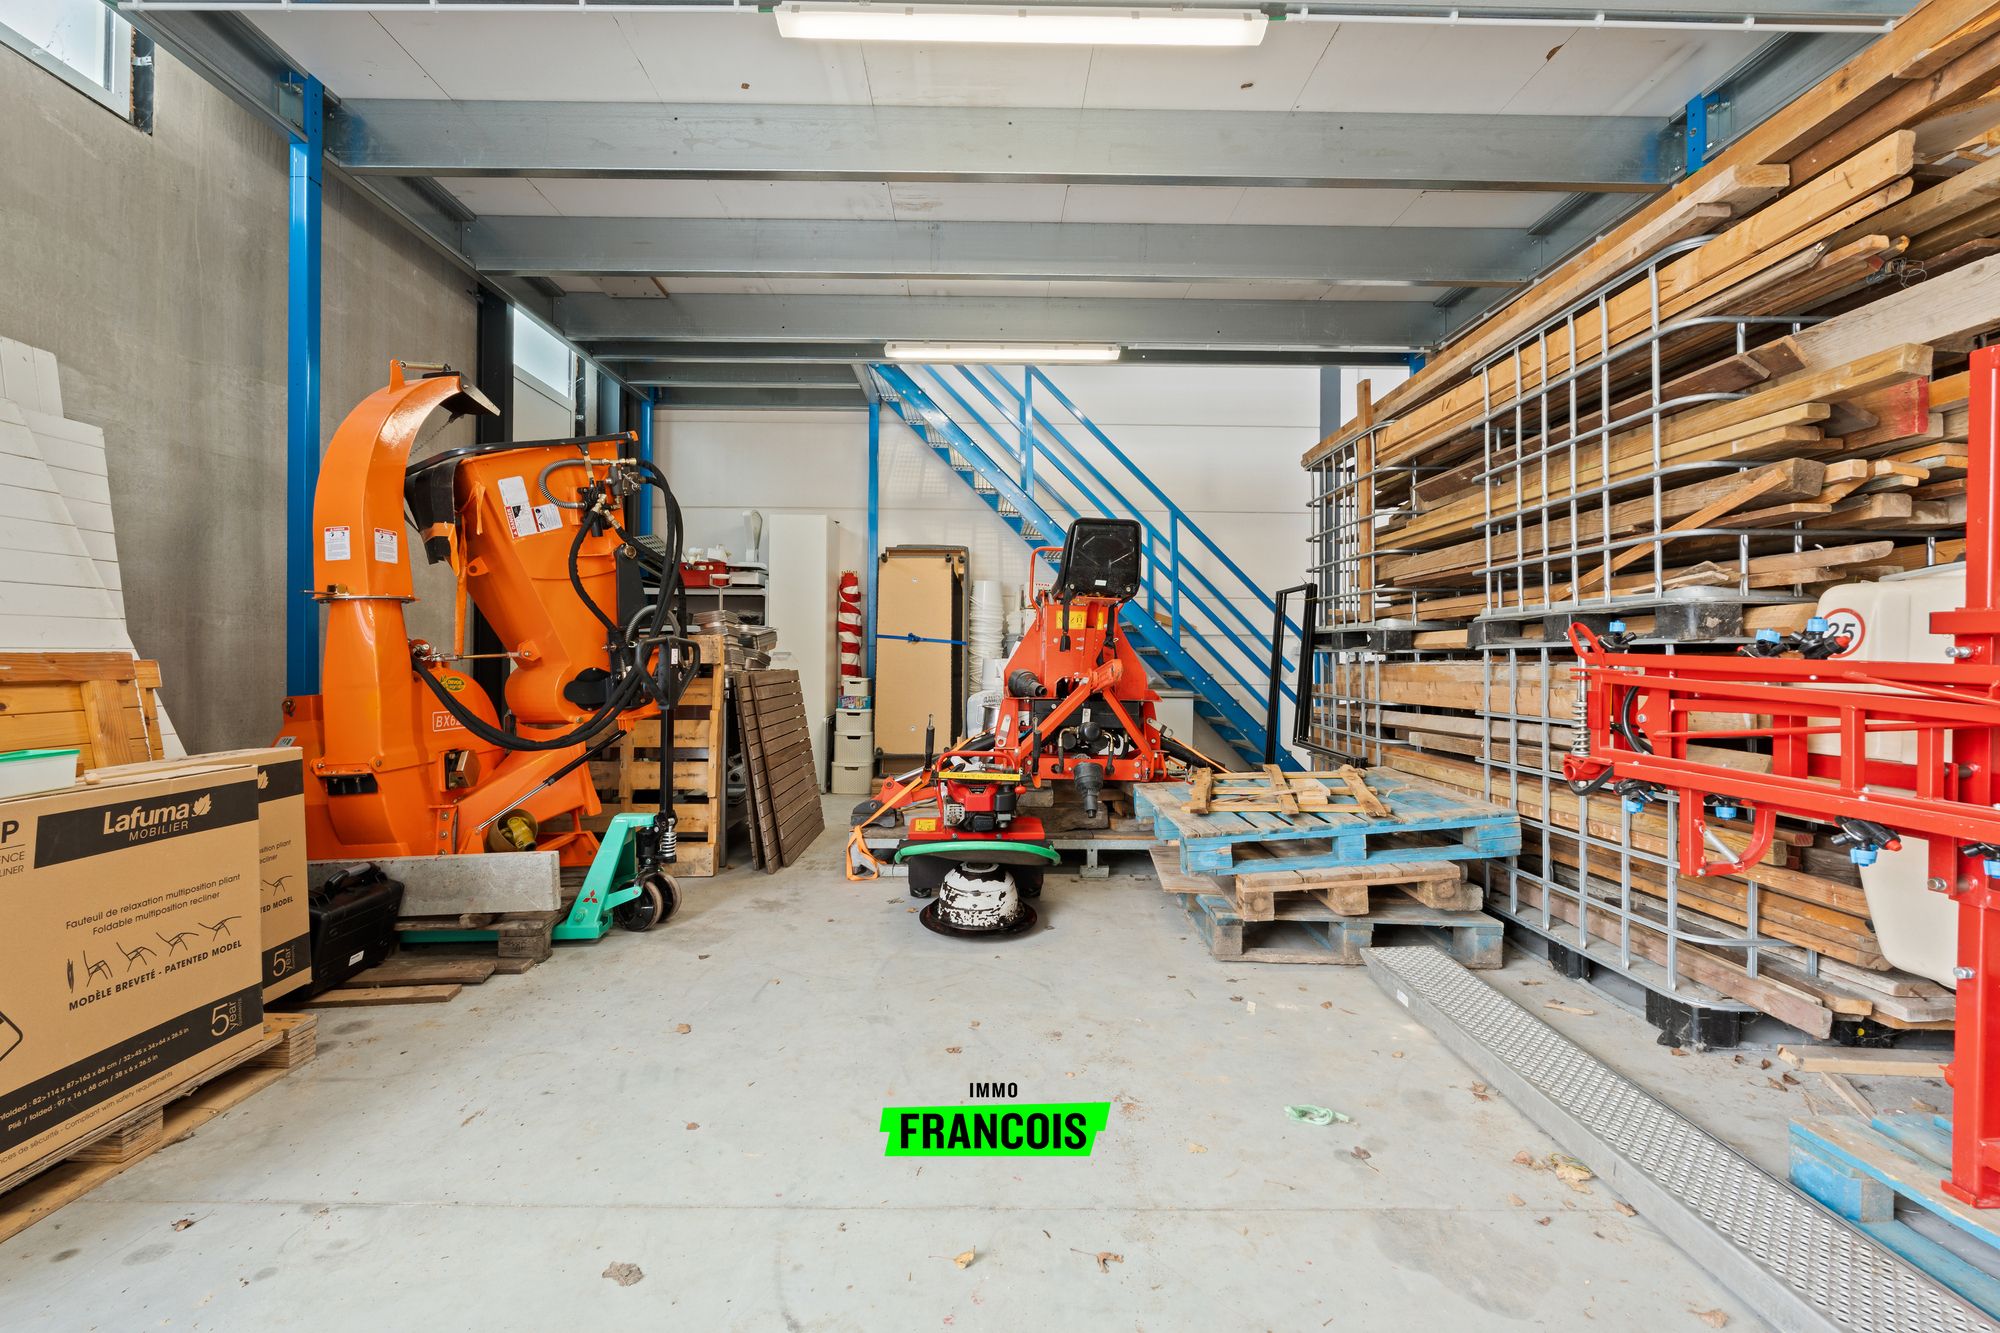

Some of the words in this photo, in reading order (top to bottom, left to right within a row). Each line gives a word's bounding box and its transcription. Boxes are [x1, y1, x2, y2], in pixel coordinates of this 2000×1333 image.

[1828, 622, 1856, 641] 25
[103, 802, 189, 835] Lafuma
[128, 820, 189, 842] MOBILIER
[65, 912, 104, 930] Fauteuil
[105, 908, 118, 918] de
[120, 895, 164, 914] relaxation
[165, 880, 217, 900] multiposition
[218, 873, 241, 887] pliant
[92, 917, 133, 936] Foldable
[135, 902, 188, 923] multiposition
[189, 892, 220, 906] recliner
[68, 989, 112, 1012] MODÈLE
[115, 969, 156, 993] BREVETÉ
[164, 952, 209, 974] PATENTED
[211, 939, 242, 957] MODEL
[273, 949, 286, 977] 5
[211, 1003, 230, 1037] 5
[228, 1002, 240, 1031] year
[97, 1065, 106, 1074] 68
[106, 1062, 118, 1070] cm
[29, 1104, 53, 1121] folded
[57, 1098, 66, 1107] 97
[73, 1091, 82, 1099] 16
[88, 1083, 97, 1092] 68
[98, 1077, 109, 1087] cm
[64, 1108, 100, 1130] Compliant
[136, 1071, 173, 1094] requirements
